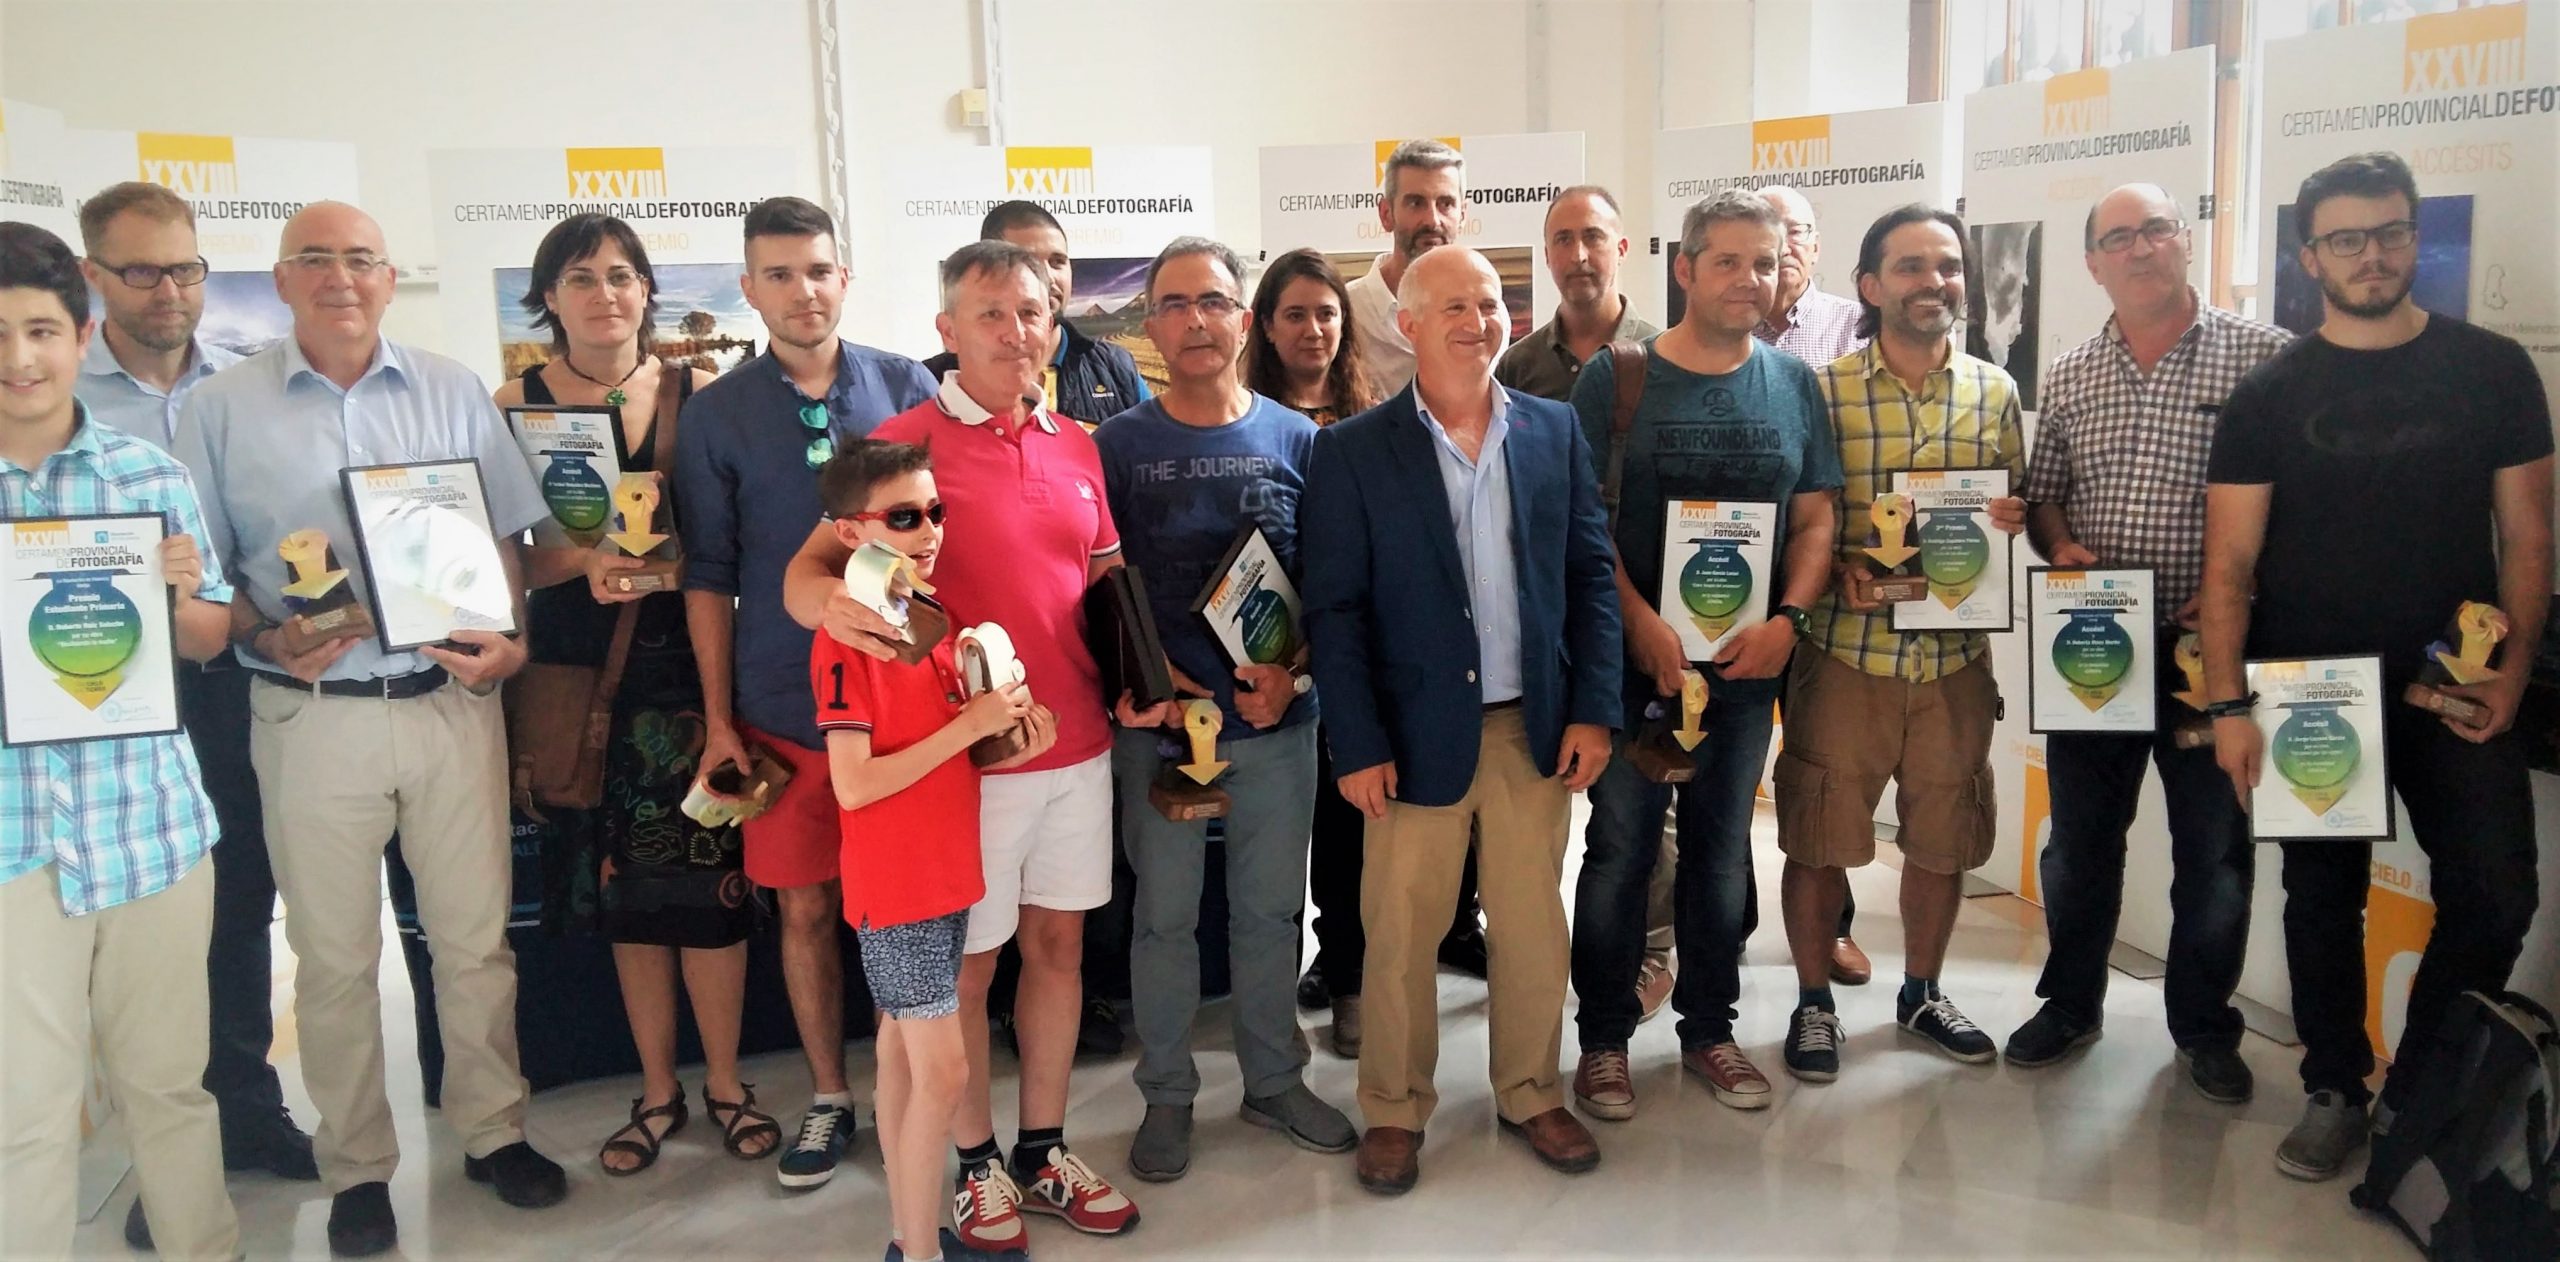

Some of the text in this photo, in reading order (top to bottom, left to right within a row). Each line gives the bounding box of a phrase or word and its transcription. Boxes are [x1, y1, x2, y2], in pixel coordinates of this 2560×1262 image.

[2406, 37, 2521, 93] XXVIII
[1754, 138, 1828, 169] XXVIII
[572, 170, 663, 198] XXVIII
[1008, 168, 1091, 194] XXVIII
[1656, 427, 1782, 450] NEWFOUNDLAND
[1136, 456, 1275, 484] THE JOURNEY
[828, 661, 849, 710] 1
